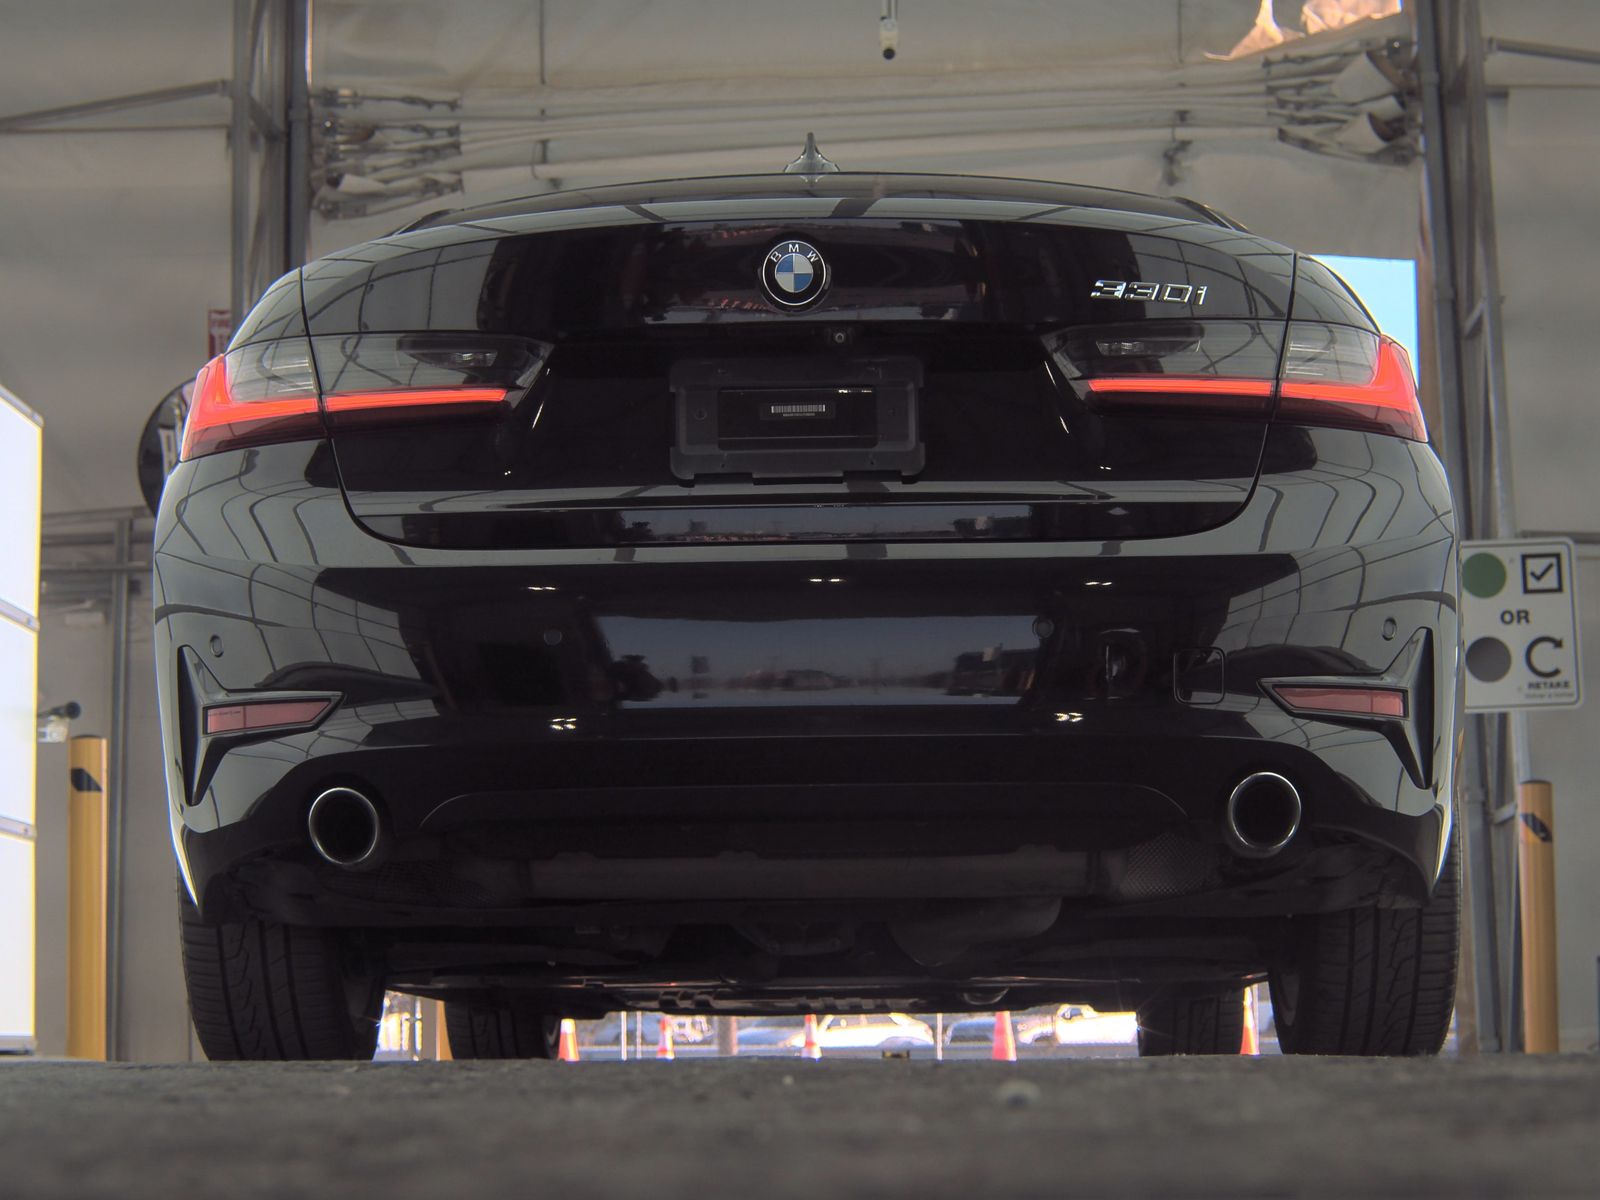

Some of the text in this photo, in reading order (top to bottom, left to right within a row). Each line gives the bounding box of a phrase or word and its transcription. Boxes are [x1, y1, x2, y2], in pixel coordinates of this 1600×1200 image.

[770, 244, 819, 262] BMW
[1091, 280, 1207, 305] 330i
[1500, 609, 1530, 625] OR
